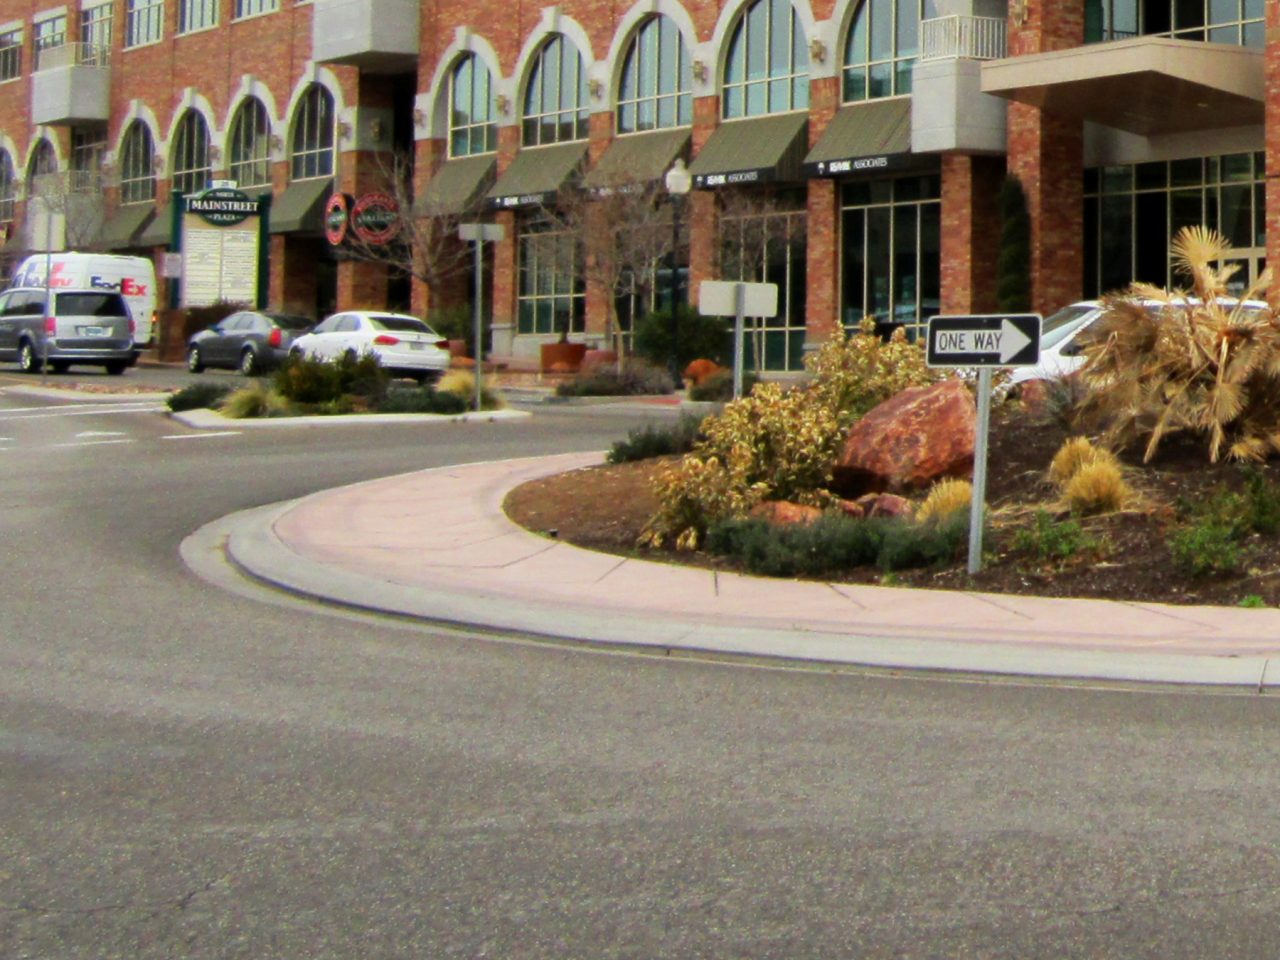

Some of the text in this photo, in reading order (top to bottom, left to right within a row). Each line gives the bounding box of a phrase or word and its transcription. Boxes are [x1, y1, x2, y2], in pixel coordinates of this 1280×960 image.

[191, 200, 258, 211] MAINSTREET
[939, 332, 1002, 351] ONE WAY
